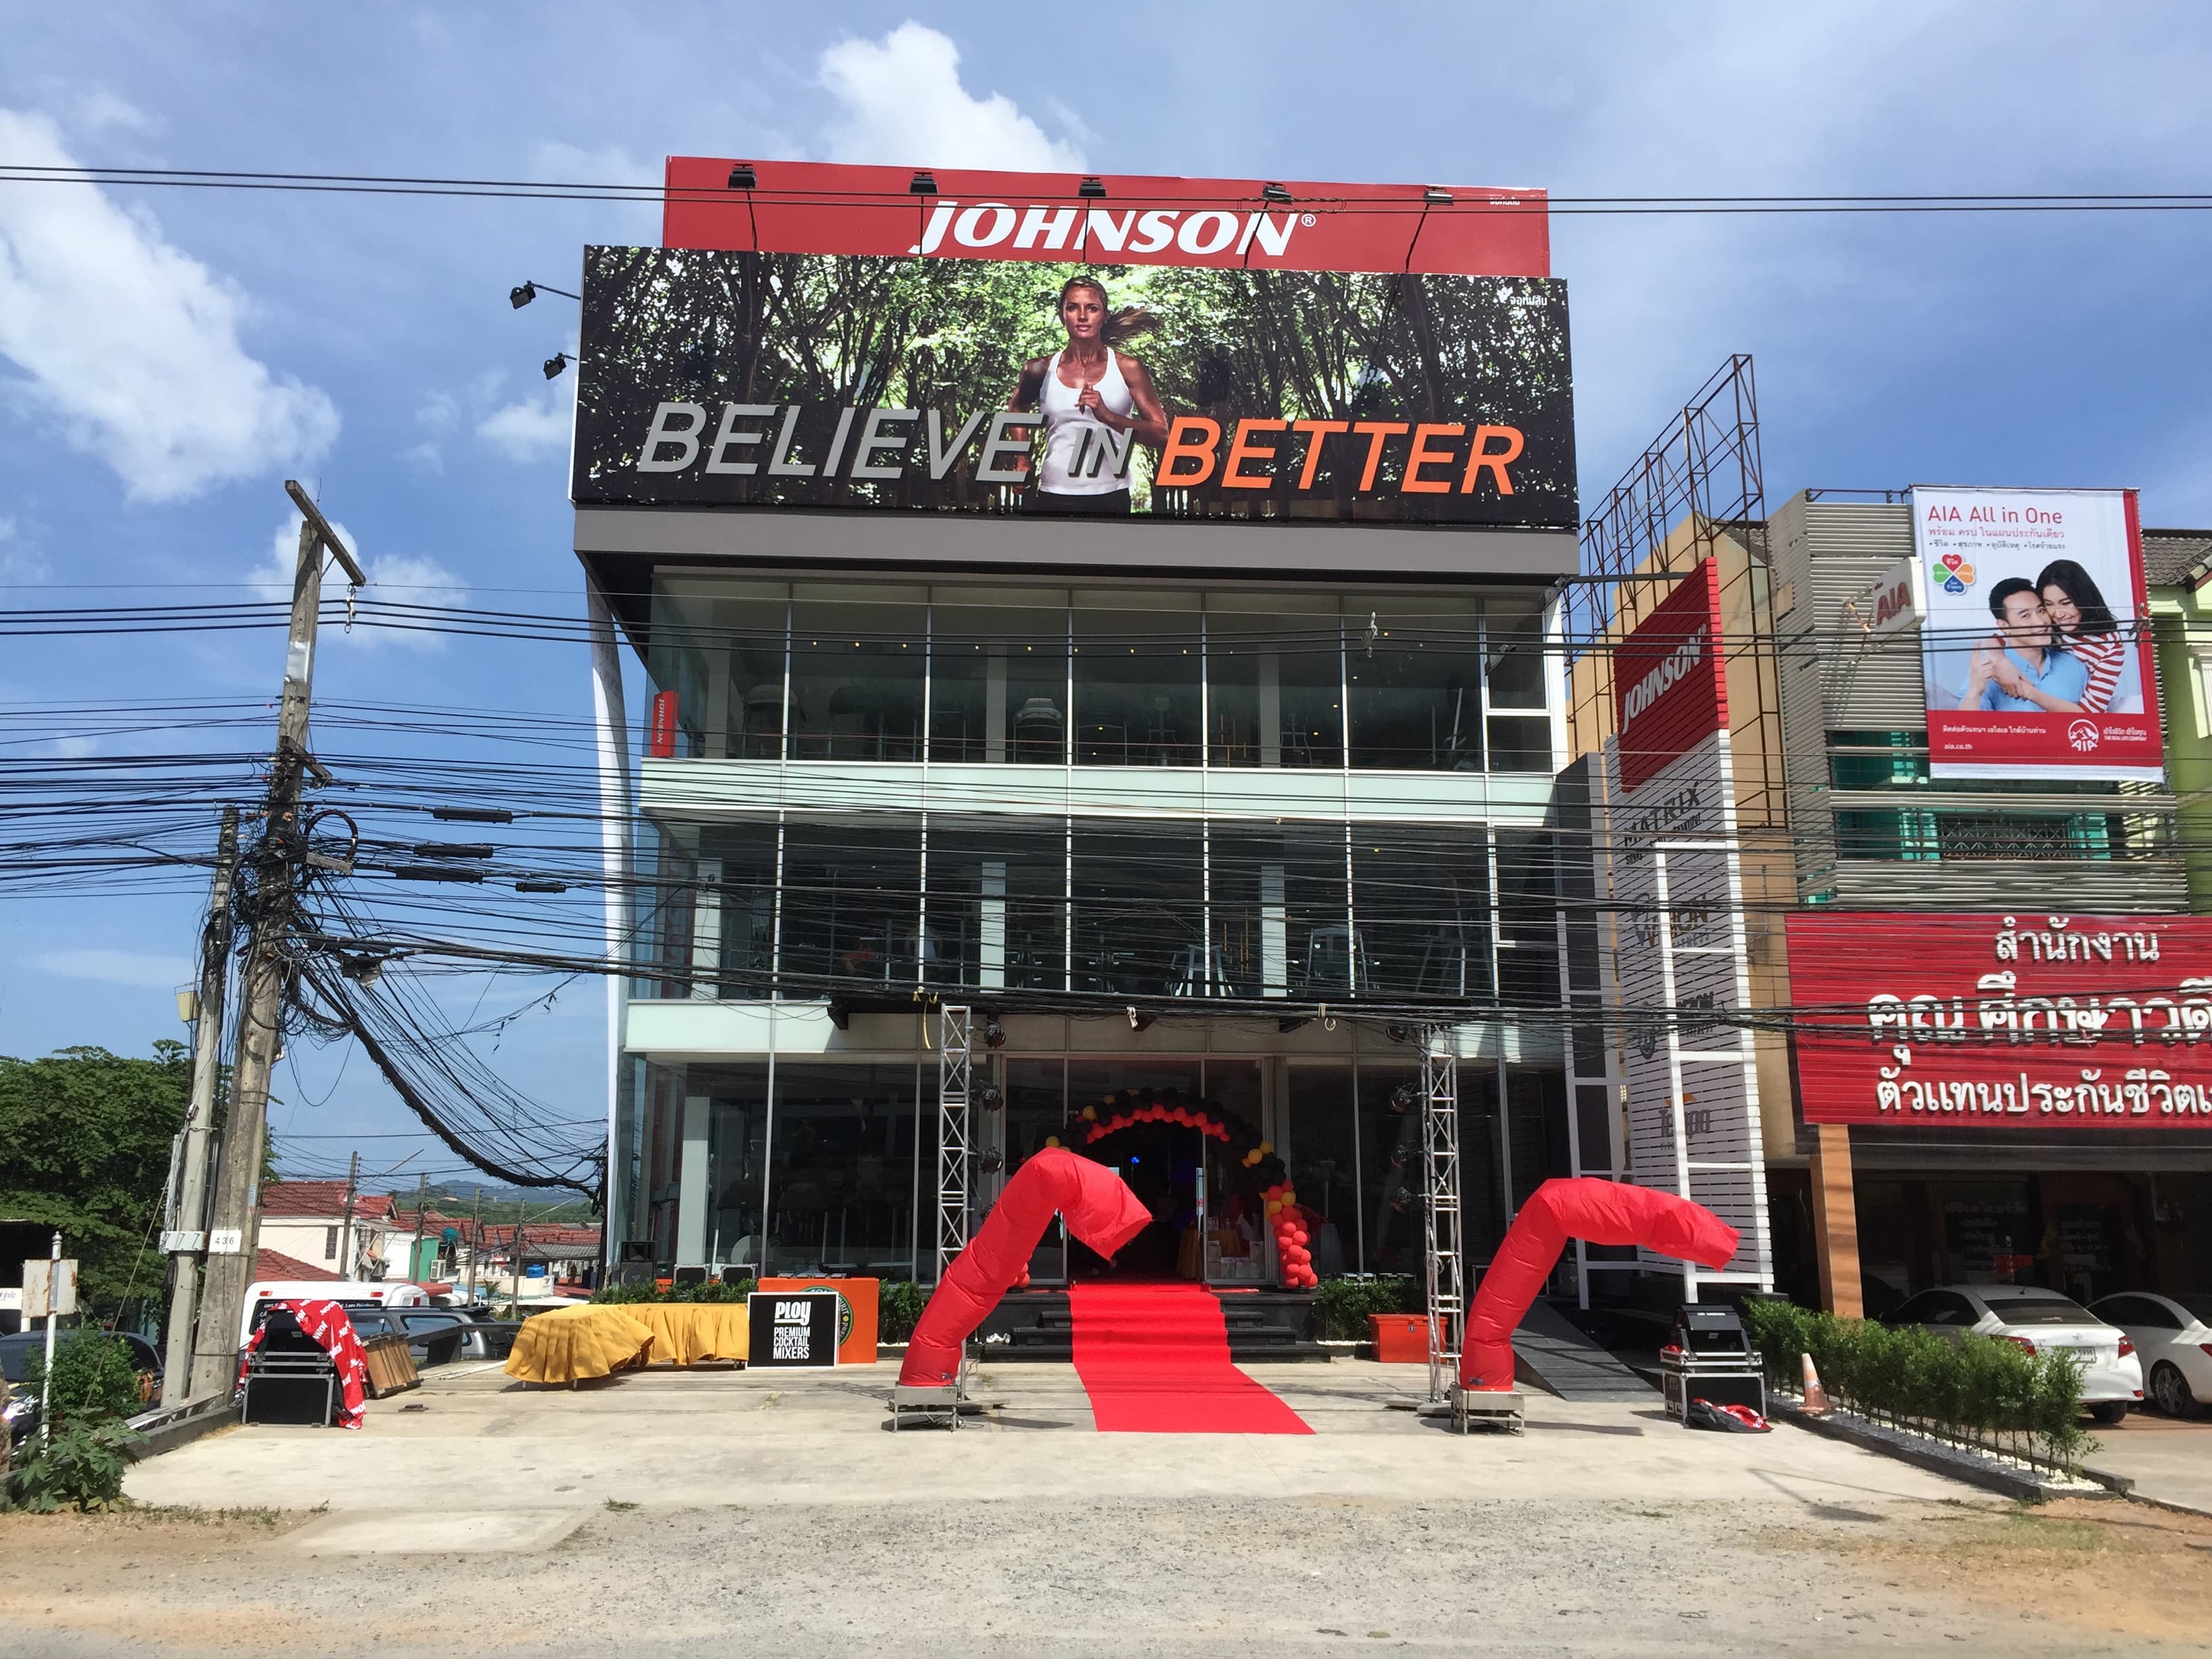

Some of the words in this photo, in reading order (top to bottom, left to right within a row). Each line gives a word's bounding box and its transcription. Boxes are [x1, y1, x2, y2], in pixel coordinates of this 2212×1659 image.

[907, 201, 1299, 256] JOHNSON
[636, 402, 1048, 483] BELIEVE
[1068, 427, 1133, 478] IN
[1155, 417, 1524, 495] BETTER
[1928, 506, 1962, 522] AIA
[1969, 506, 1996, 523] All
[2002, 507, 2019, 523] in
[2026, 507, 2063, 524] One
[1928, 525, 1955, 536] พร้อม
[1877, 581, 1911, 626] AIA
[1622, 629, 1703, 735] JOHNSON
[2071, 739, 2098, 752] AIA
[1996, 916, 2160, 961] สำนักงาน
[1867, 994, 1967, 1065] คุณ
[1876, 1067, 2212, 1113] ตัวแทนประกันชีวิตเ
[1659, 1109, 1711, 1139] Tepo
[215, 1237, 234, 1245] 436
[773, 1336, 810, 1347] COCKTAIL
[774, 1326, 811, 1337] PREMIUM
[773, 1347, 810, 1359] MIXERS
